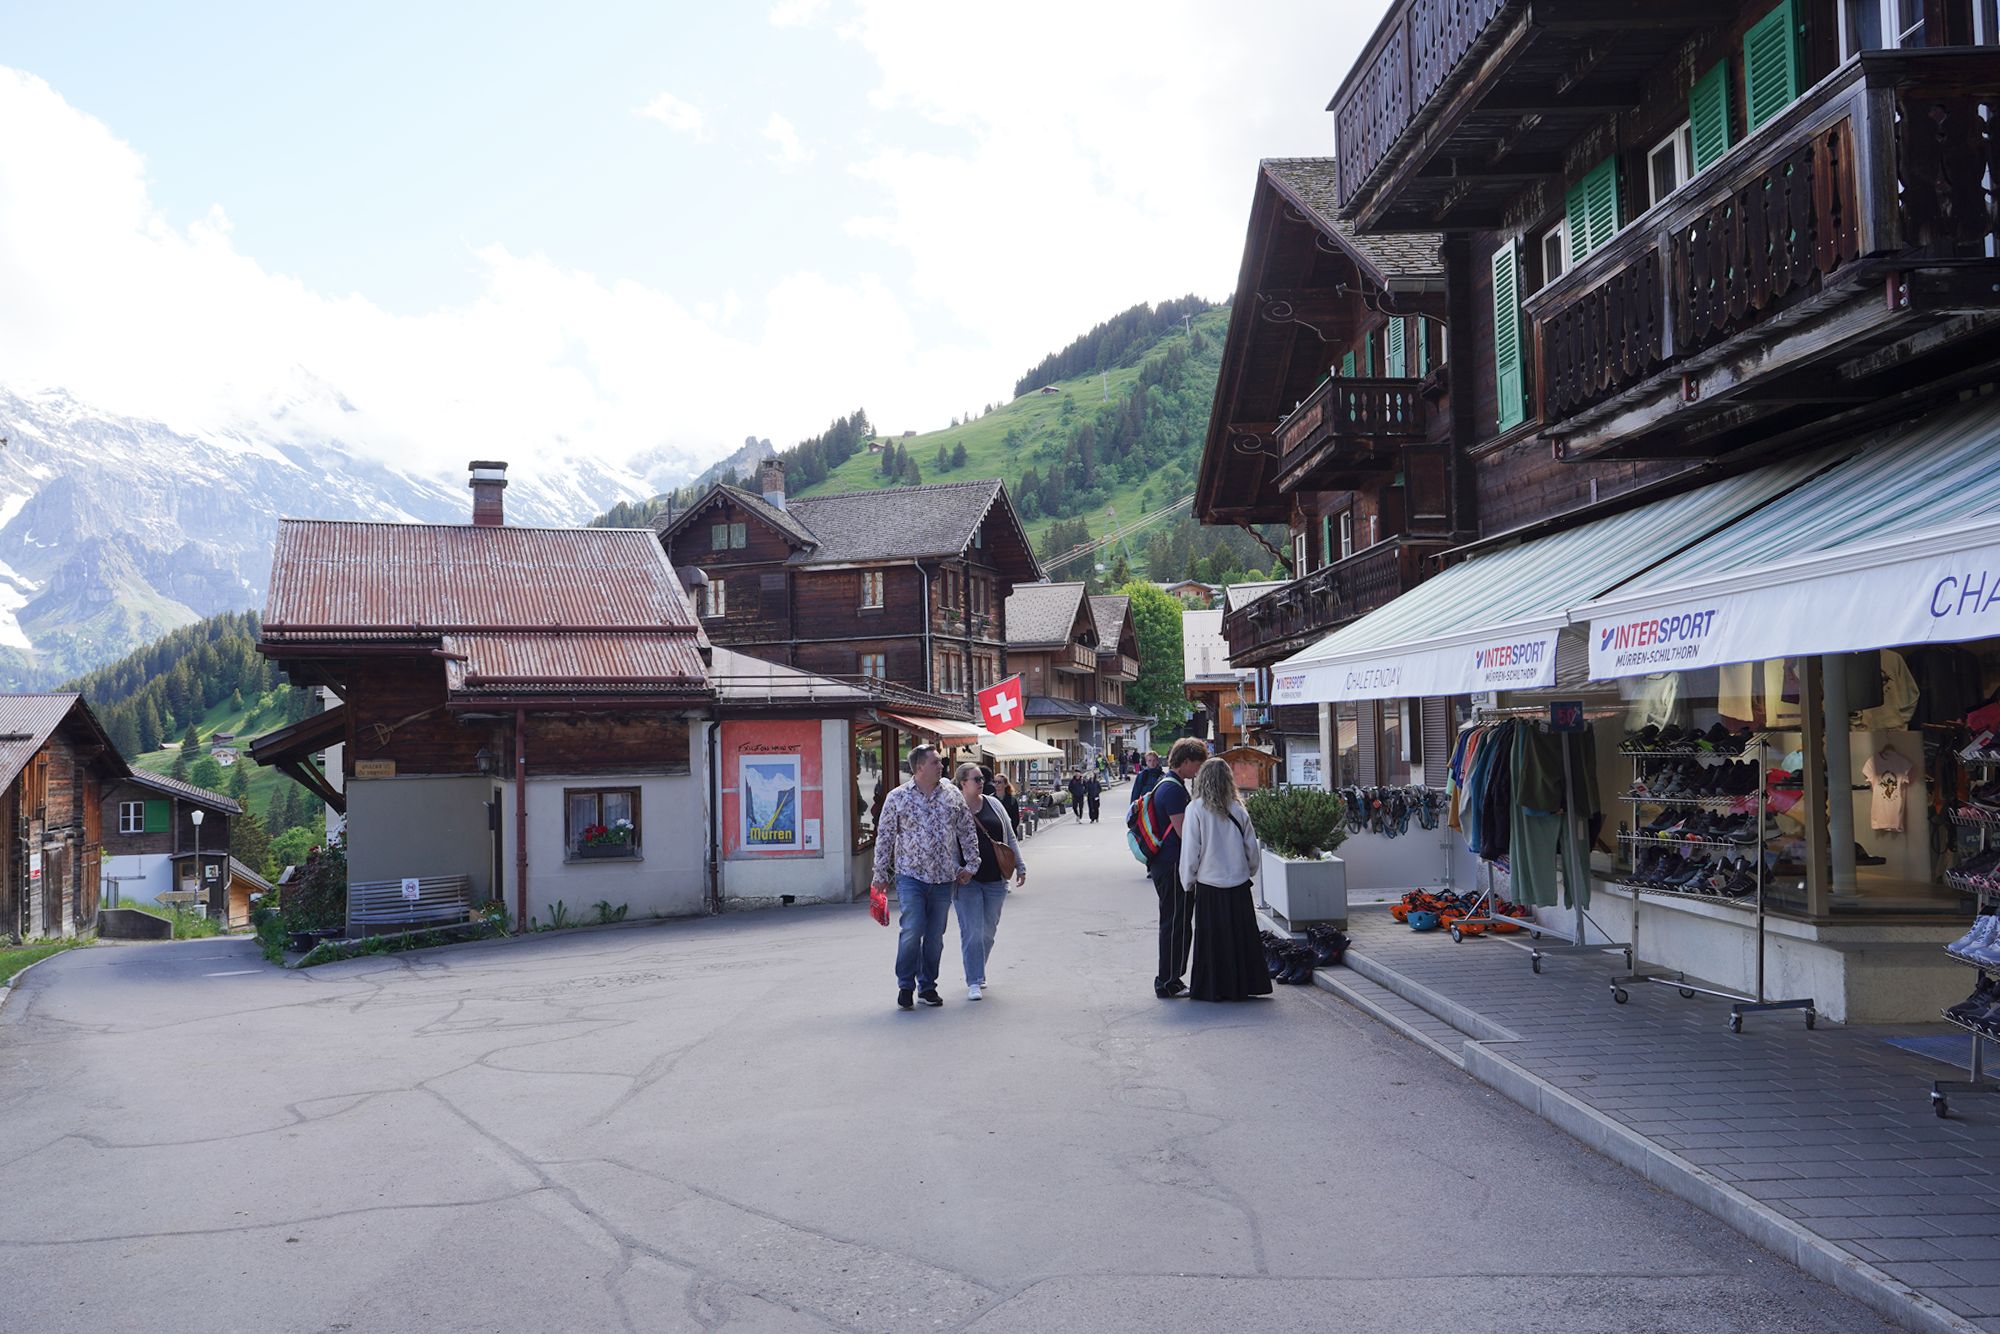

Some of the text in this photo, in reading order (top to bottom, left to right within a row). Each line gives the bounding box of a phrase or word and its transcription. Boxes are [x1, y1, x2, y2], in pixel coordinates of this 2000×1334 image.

[1614, 609, 1716, 650] INTERSPORT
[1483, 640, 1547, 669] INTERSPORT
[1615, 645, 1701, 668] MÜRREN-SCHILTHORN
